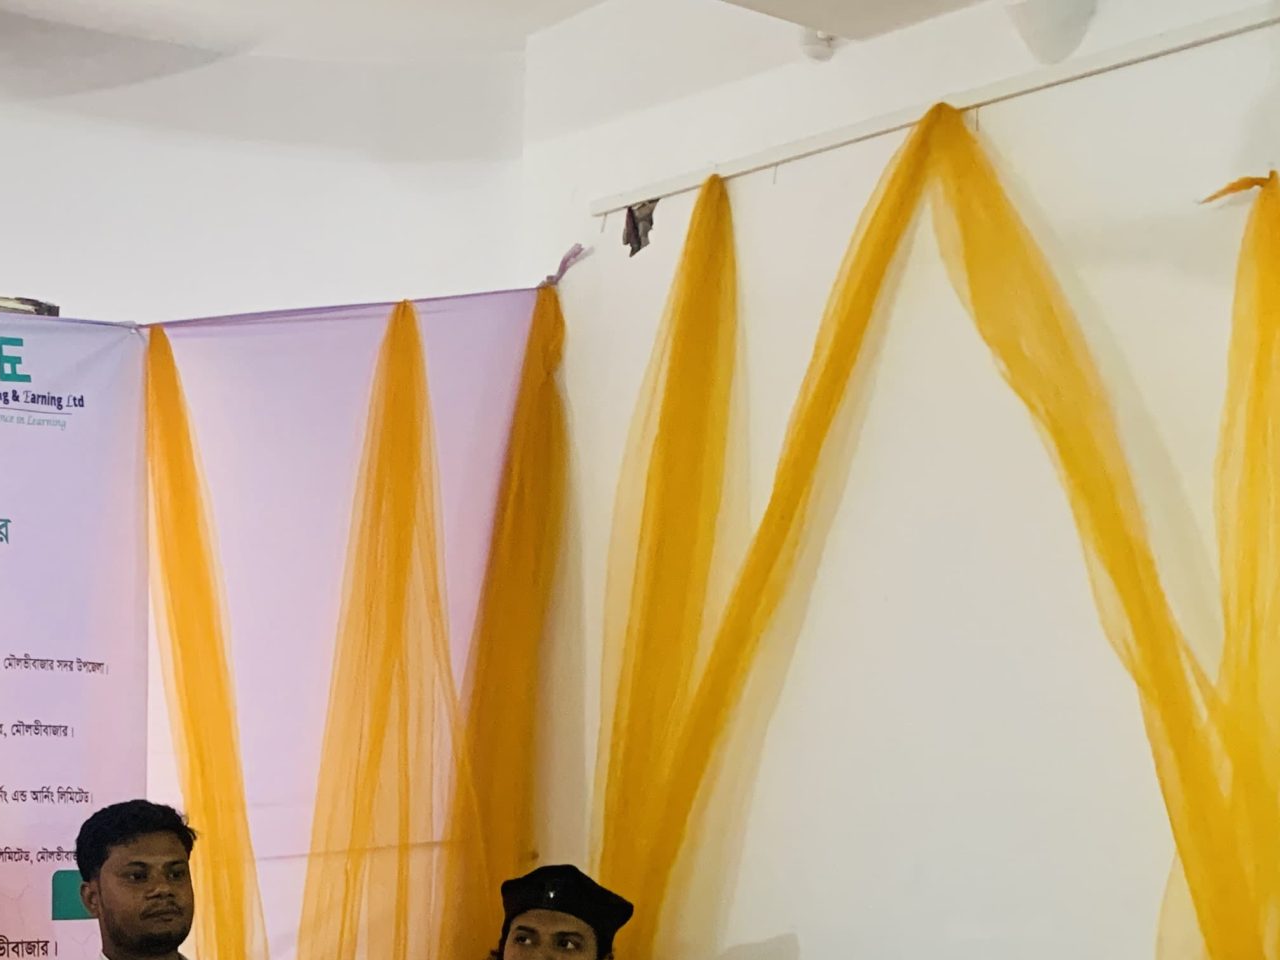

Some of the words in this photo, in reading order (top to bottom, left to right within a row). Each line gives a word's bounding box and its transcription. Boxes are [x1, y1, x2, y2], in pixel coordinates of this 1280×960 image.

[12, 389, 20, 402] &
[23, 390, 63, 410] Earning
[66, 395, 84, 408] Ltd
[16, 414, 25, 425] in
[27, 415, 66, 430] Learning
[57, 659, 73, 672] সদর
[12, 790, 27, 803] এন্ড
[30, 786, 55, 804] আর্নিং
